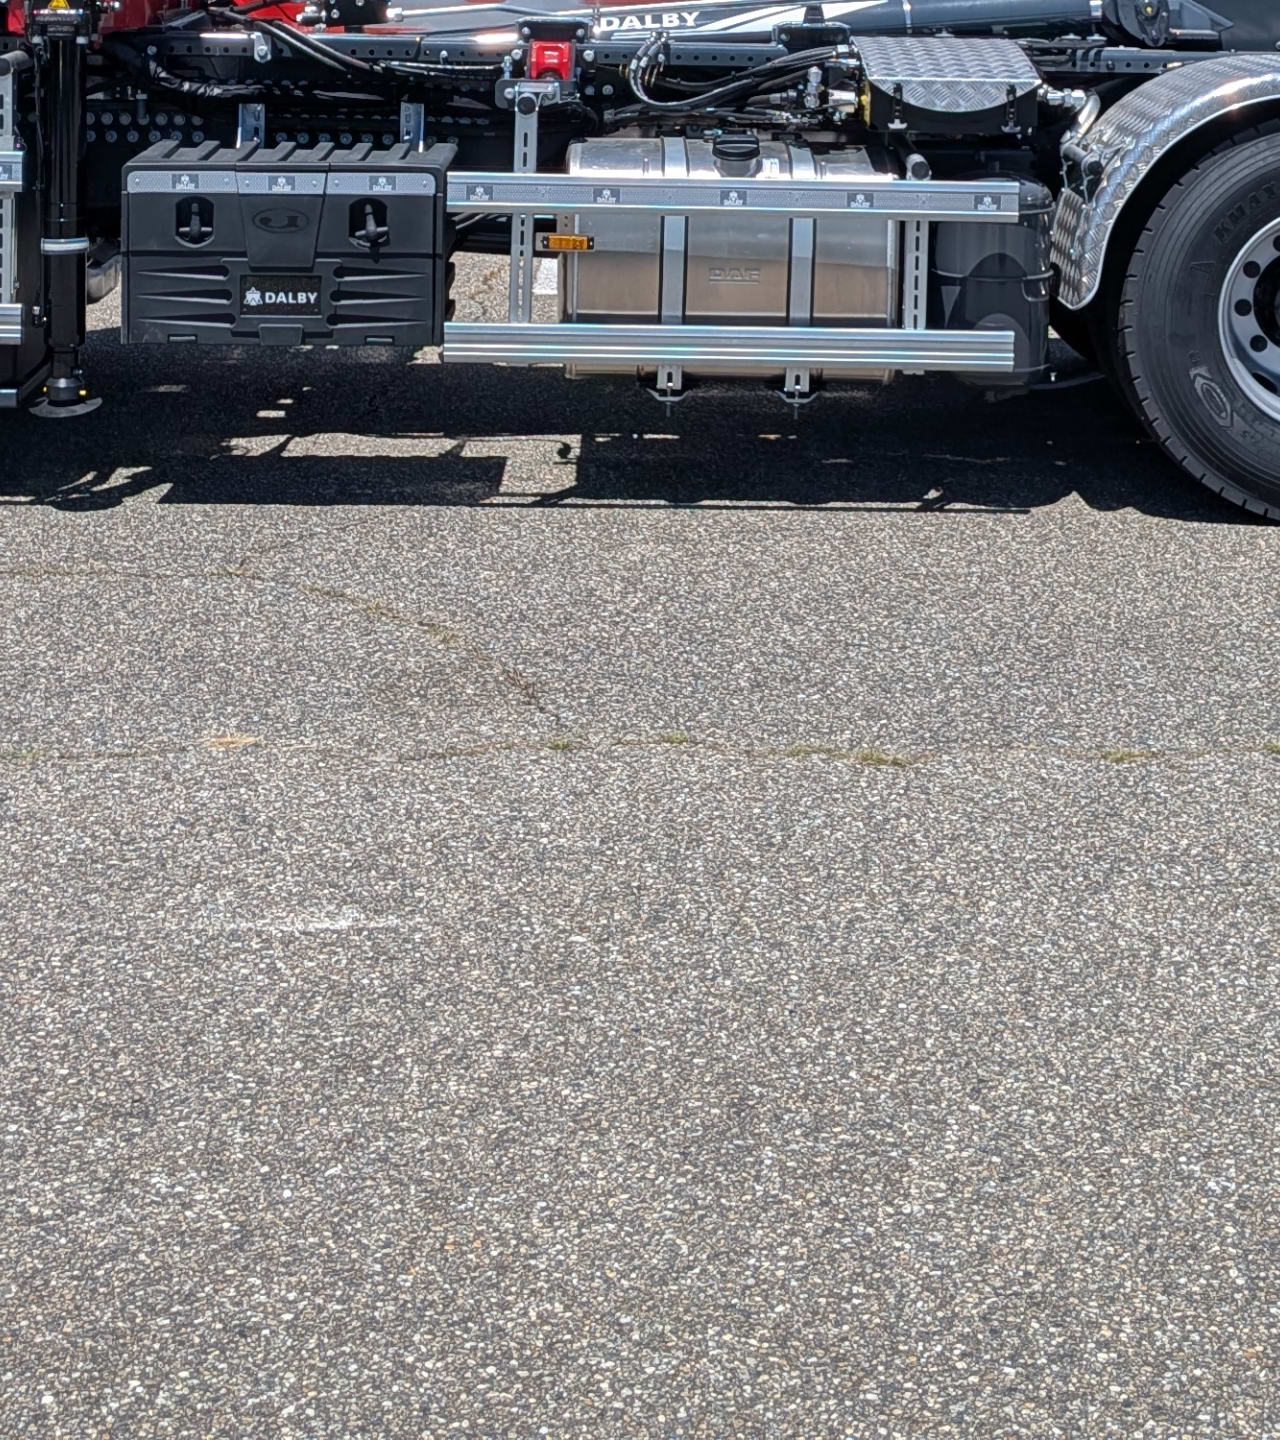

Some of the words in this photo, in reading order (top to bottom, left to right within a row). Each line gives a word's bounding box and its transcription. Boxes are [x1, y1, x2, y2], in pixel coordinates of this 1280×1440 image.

[599, 11, 700, 31] DALBY
[708, 268, 761, 280] DAF
[265, 291, 318, 305] DALBY
